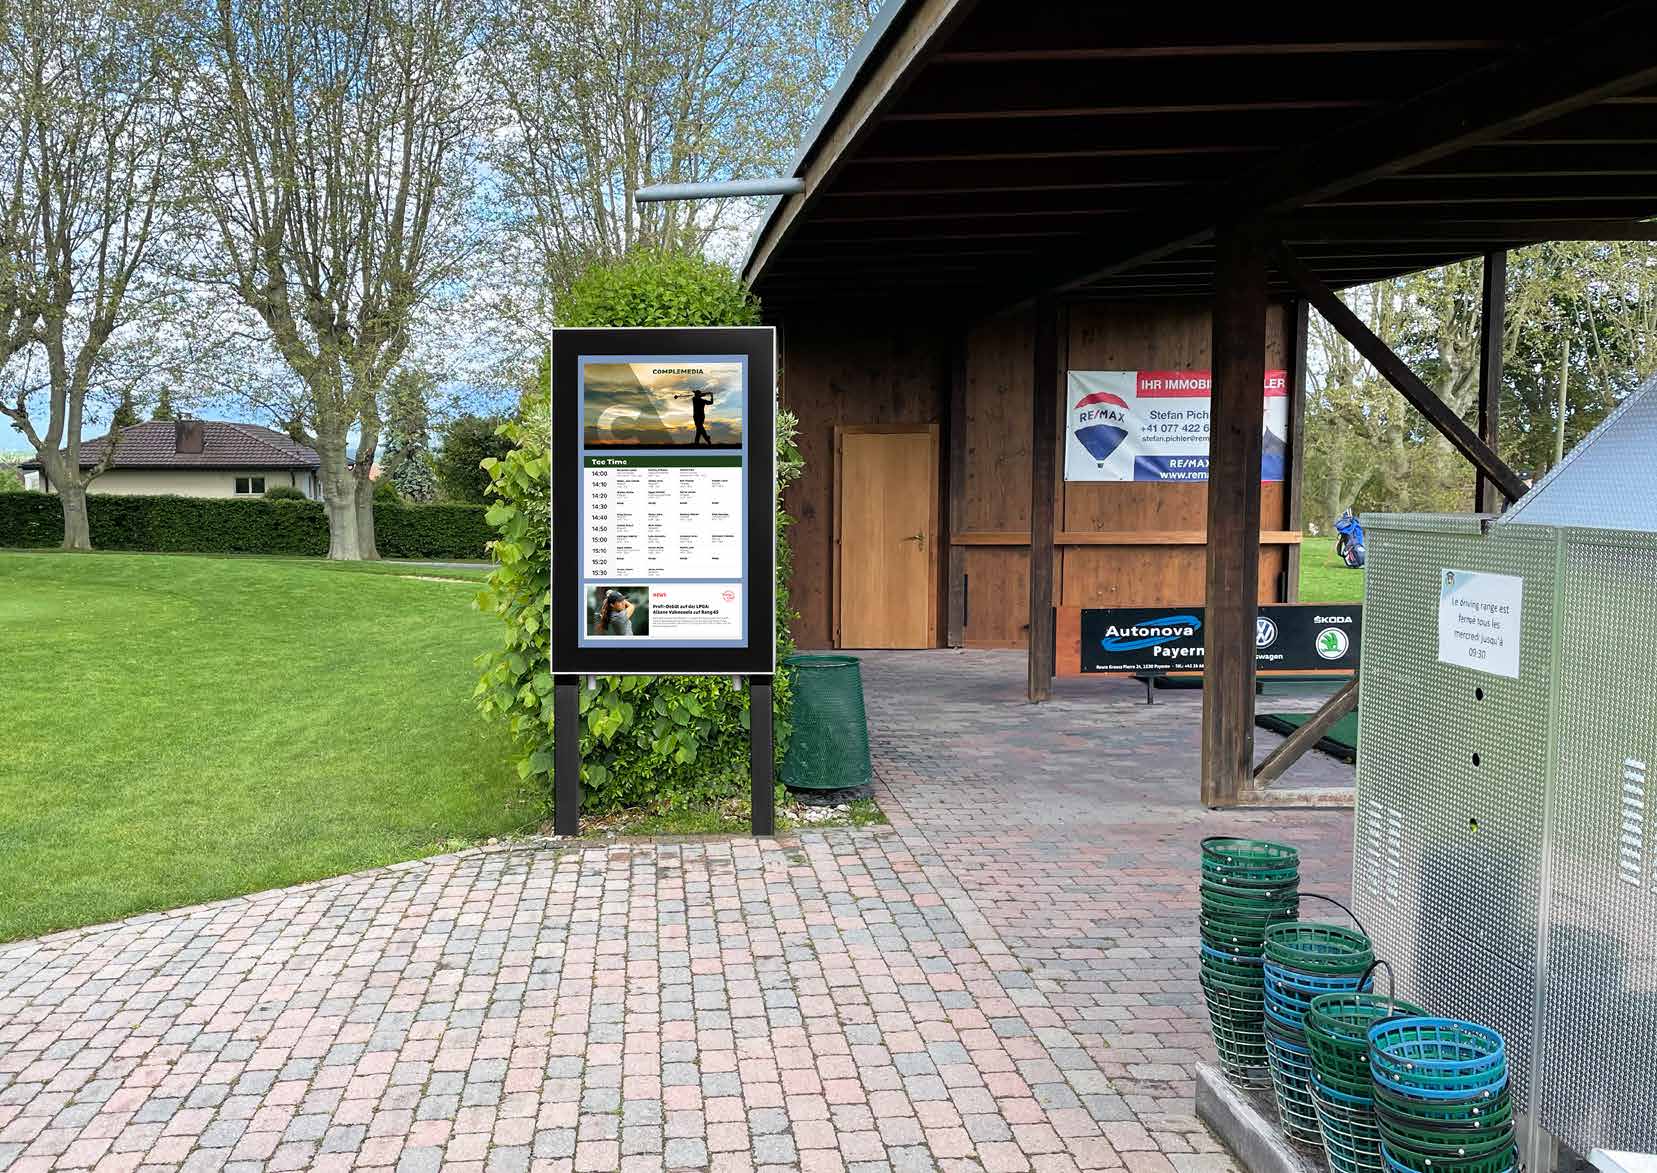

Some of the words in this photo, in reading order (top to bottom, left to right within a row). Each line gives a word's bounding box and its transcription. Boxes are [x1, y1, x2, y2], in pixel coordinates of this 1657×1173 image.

[1141, 379, 1162, 390] IHR
[1165, 379, 1211, 390] IMMOBI
[1263, 378, 1285, 388] LER
[1079, 409, 1125, 423] RE/MAX
[1150, 410, 1183, 420] Stefan
[1187, 410, 1209, 420] Pich
[1141, 424, 1157, 433] +41
[1161, 424, 1179, 433] 077
[1182, 424, 1200, 433] 422
[1203, 424, 1209, 433] 6
[1142, 434, 1209, 443] stefan.pichler@rem
[1459, 599, 1480, 611] driving
[1480, 602, 1498, 614] range
[1499, 605, 1510, 614] est
[1313, 615, 1353, 624] ŠKODA
[1477, 617, 1491, 628] tous
[1491, 617, 1501, 629] les
[1105, 625, 1194, 637] Autonova
[1153, 646, 1205, 659] Payern
[1256, 654, 1284, 662] swagen
